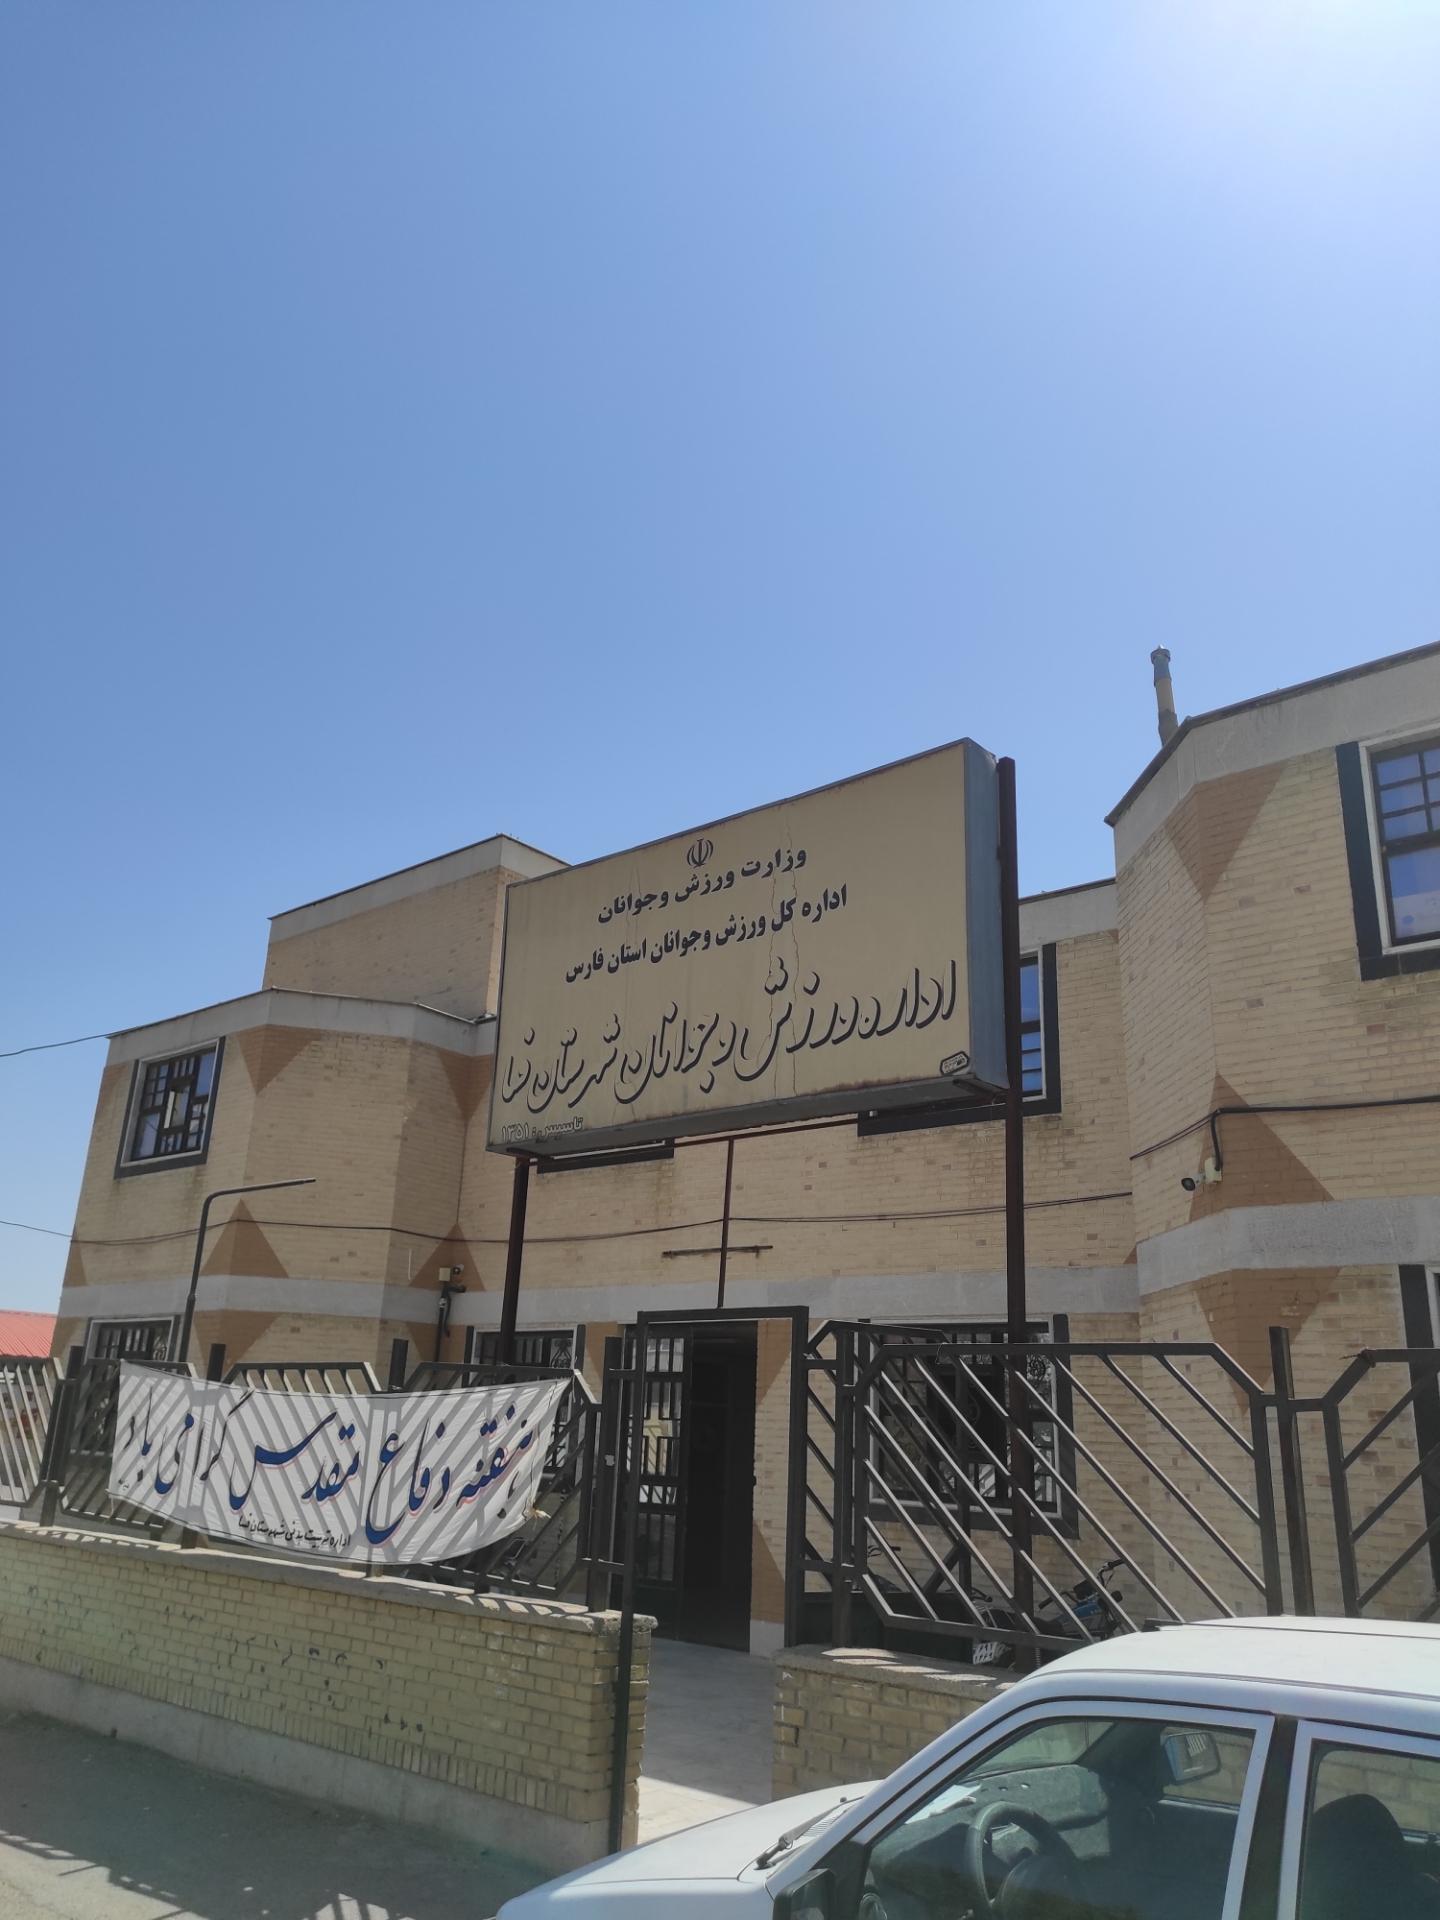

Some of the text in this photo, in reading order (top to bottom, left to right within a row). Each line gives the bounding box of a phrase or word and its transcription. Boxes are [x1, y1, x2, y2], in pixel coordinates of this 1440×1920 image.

[741, 848, 807, 878] وزارت
[674, 869, 735, 902] ورزش
[801, 883, 847, 923] اداره
[715, 914, 766, 945] ورزش
[771, 897, 797, 931] کل
[566, 947, 604, 983] فارس
[607, 937, 647, 973] استان
[734, 956, 859, 1082] ورزش
[858, 959, 957, 1040] اداره
[527, 1013, 621, 1115] شهرستان
[124, 1387, 153, 1482] باد
[155, 1389, 254, 1495] گرامی
[229, 1411, 360, 1511] مقدس
[366, 1417, 450, 1545] دفاع
[330, 1533, 351, 1548] اداره
